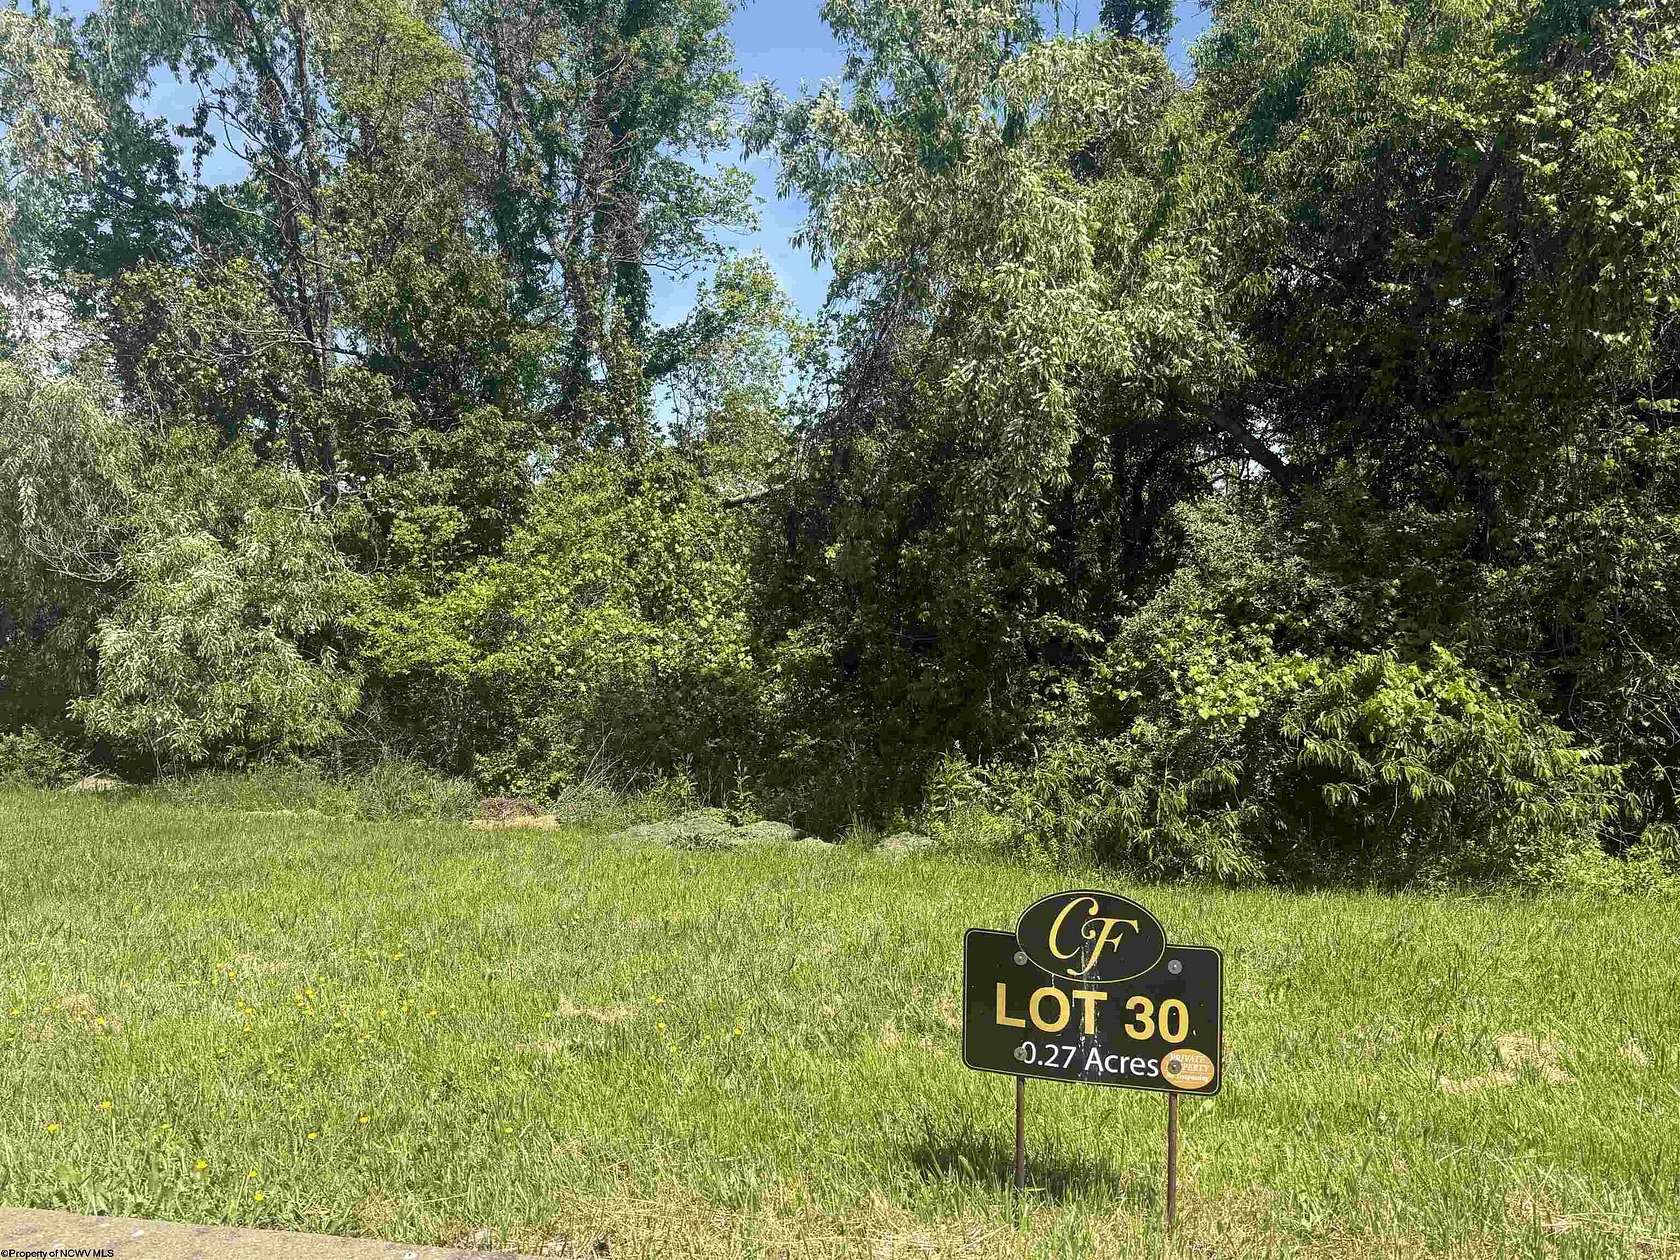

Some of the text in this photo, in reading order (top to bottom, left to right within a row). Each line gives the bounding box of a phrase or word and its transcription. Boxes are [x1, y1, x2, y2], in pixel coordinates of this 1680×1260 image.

[1048, 896, 1139, 976] CF
[996, 982, 1189, 1044] LOT 30
[1019, 1041, 1159, 1077] 0.27 Acres
